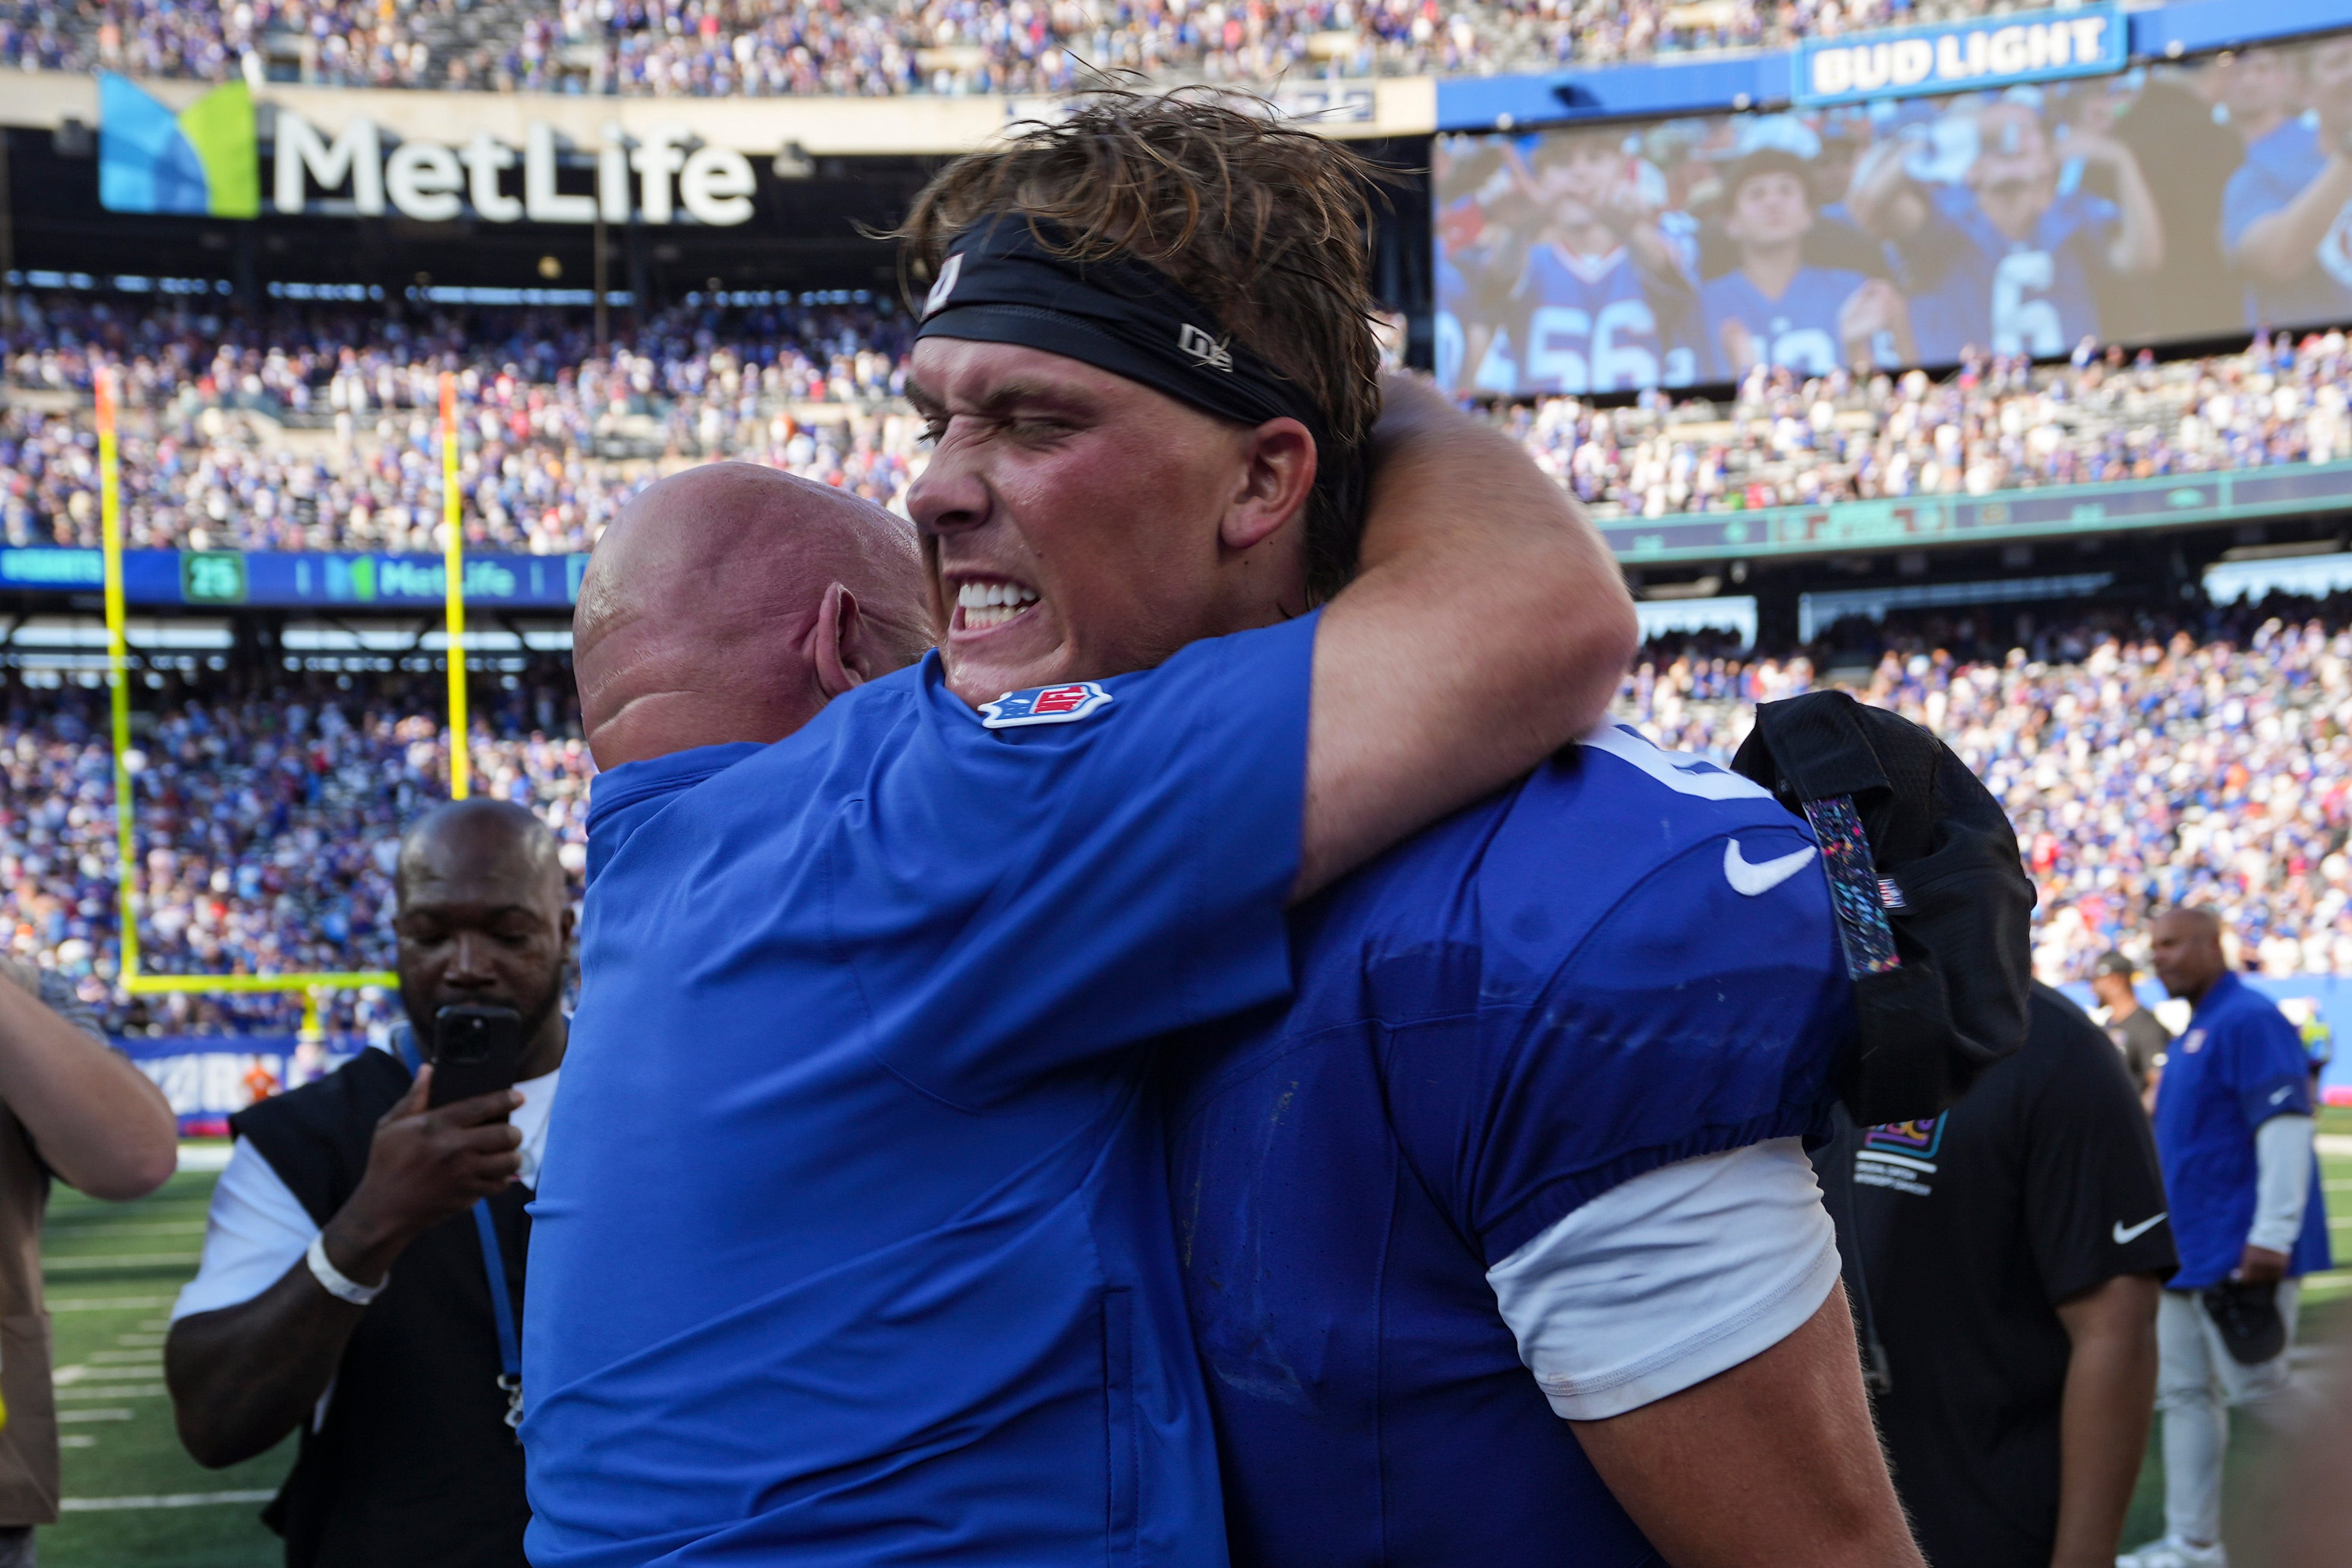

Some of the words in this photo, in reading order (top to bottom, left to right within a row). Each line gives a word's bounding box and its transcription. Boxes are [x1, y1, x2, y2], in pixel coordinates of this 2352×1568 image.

[1813, 38, 1934, 95] BUD
[1936, 16, 2107, 80] LIGHT
[274, 109, 757, 227] MetLife
[1529, 300, 1660, 393] 56
